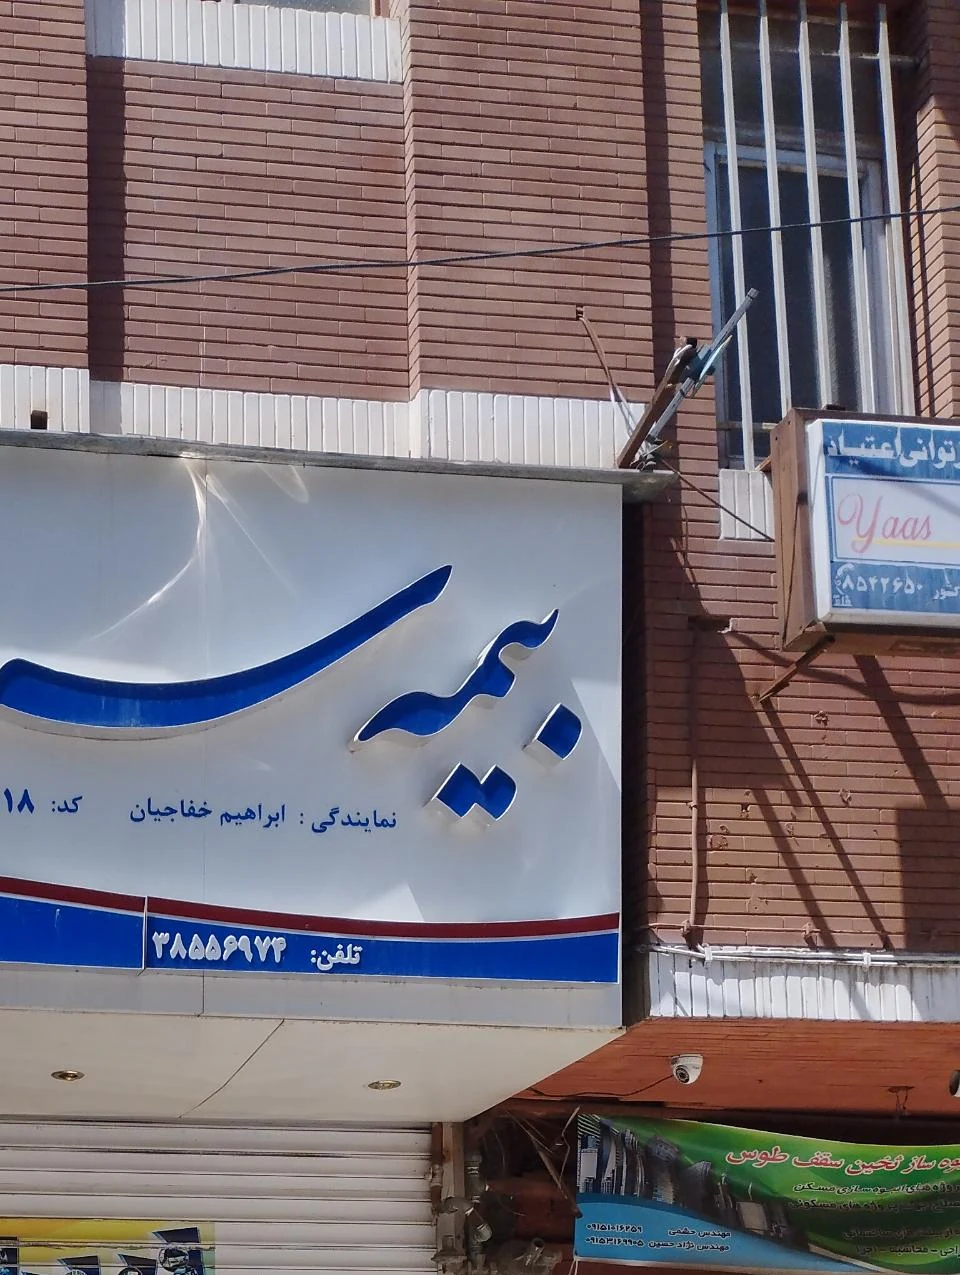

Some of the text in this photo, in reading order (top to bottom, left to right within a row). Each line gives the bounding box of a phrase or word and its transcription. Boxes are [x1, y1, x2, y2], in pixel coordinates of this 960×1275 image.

[837, 491, 933, 553] Yaas
[351, 606, 584, 826] بیمه
[129, 798, 212, 823] خفاجیان
[219, 803, 286, 827] ابراهیم
[151, 931, 287, 963] ۳۸۵۵۶۹۷۴
[726, 1146, 790, 1169] طوس
[792, 1150, 845, 1169] سقف
[697, 1230, 732, 1239] مهندس
[696, 1243, 730, 1252] مهندس
